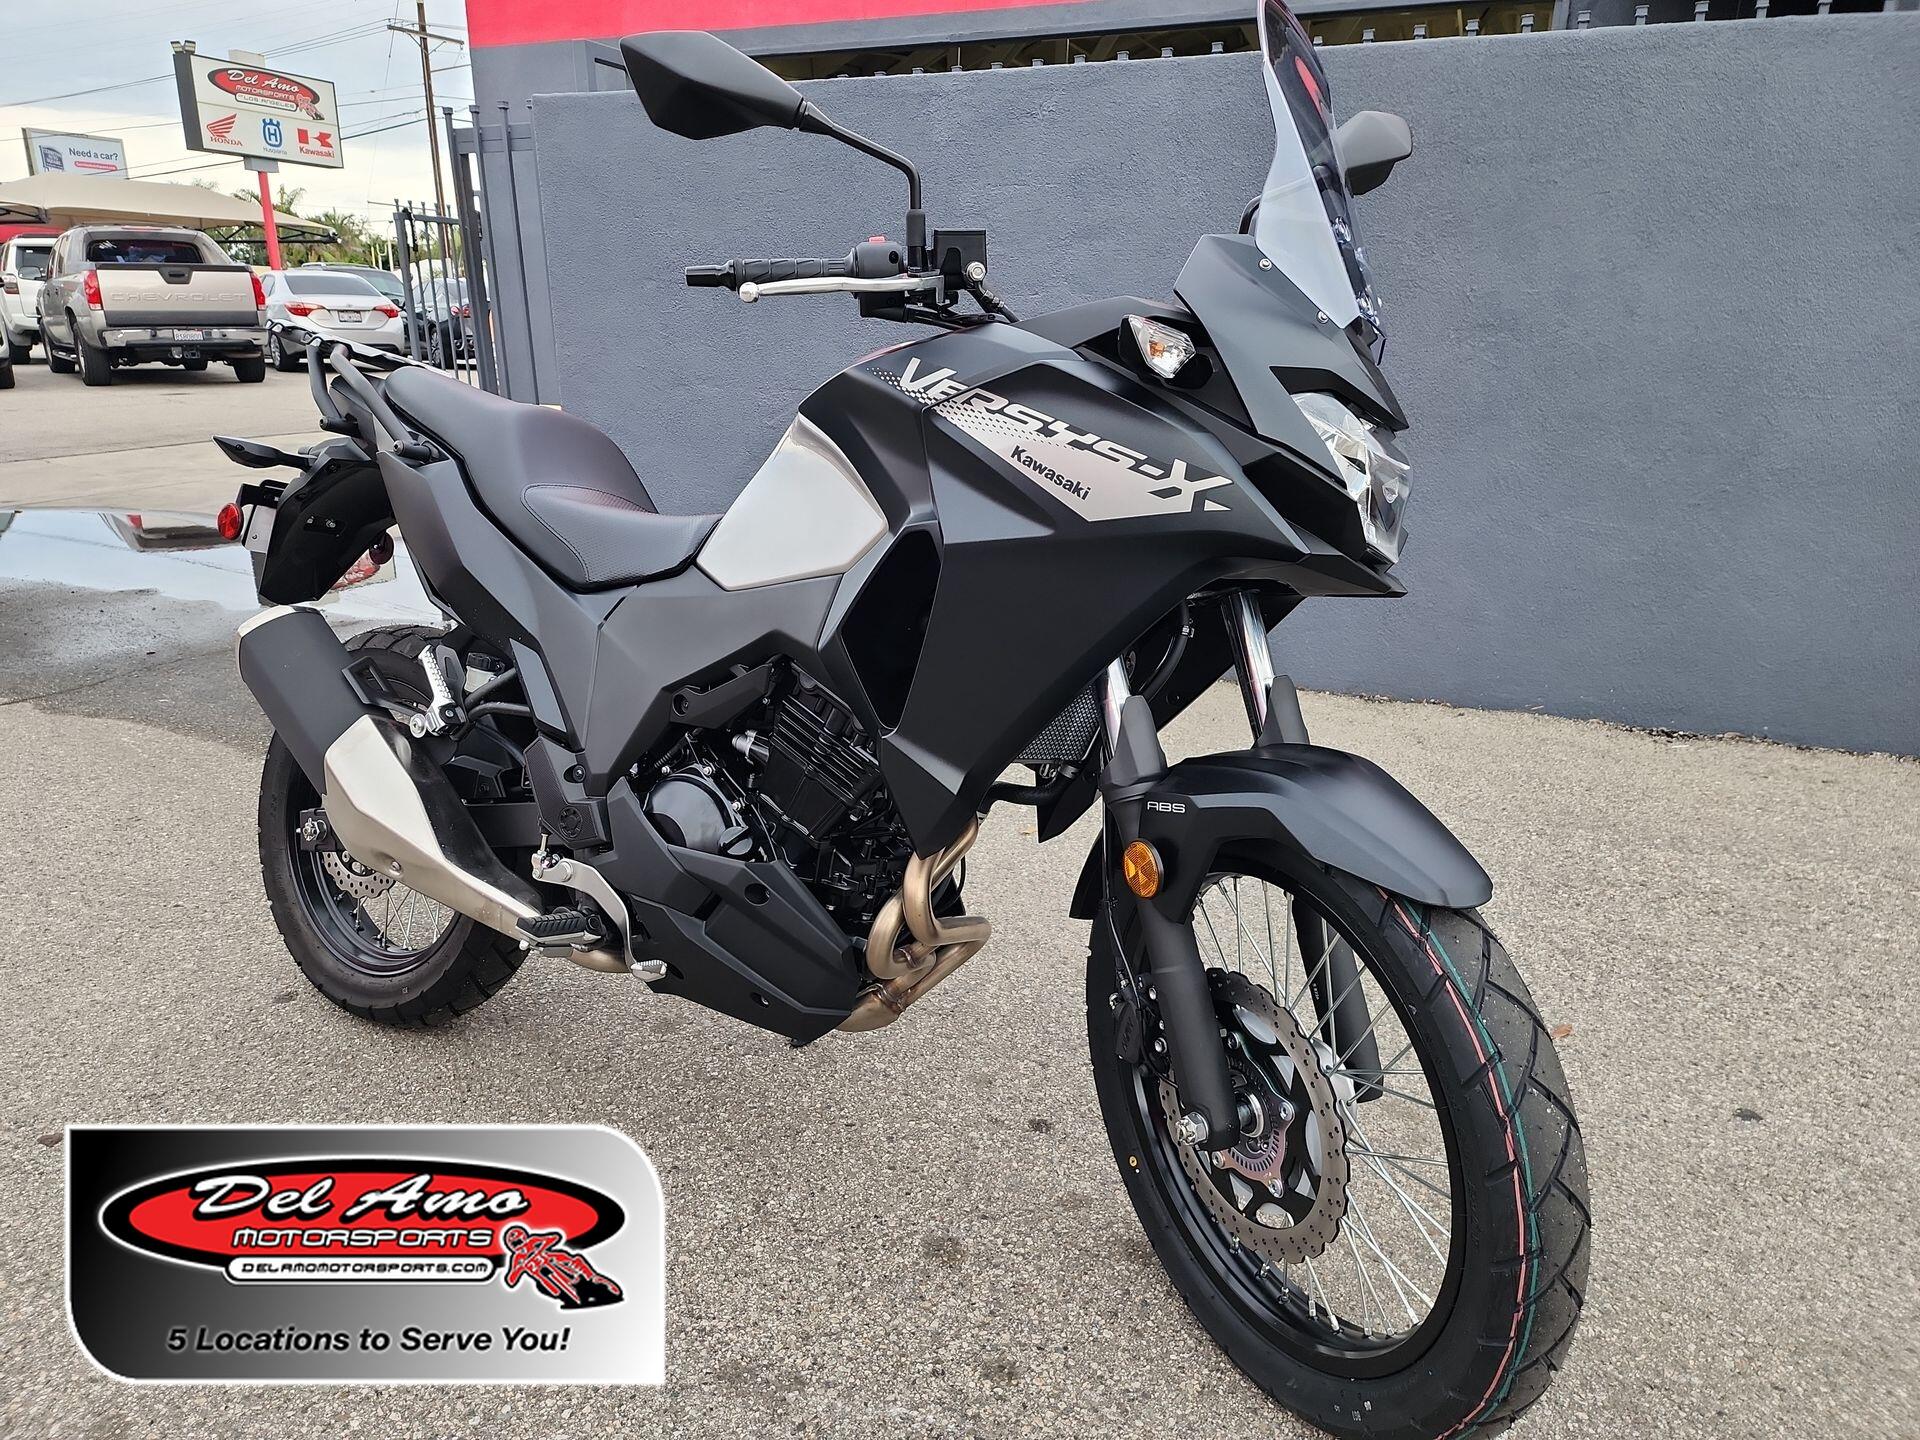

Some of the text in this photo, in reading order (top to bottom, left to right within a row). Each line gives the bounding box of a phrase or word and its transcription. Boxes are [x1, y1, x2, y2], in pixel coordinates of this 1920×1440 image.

[228, 69, 300, 93] Del Amo
[235, 84, 295, 101] MOTORSPORTS
[243, 94, 259, 103] LOS
[261, 97, 295, 109] ANGELES
[210, 136, 243, 147] HONDA
[68, 147, 92, 158] Need
[100, 152, 119, 161] car?
[299, 145, 335, 159] Kawasaki
[111, 292, 247, 302] CHEVROLET
[1010, 445, 1091, 501] Kawasaki
[1147, 800, 1186, 814] ABS
